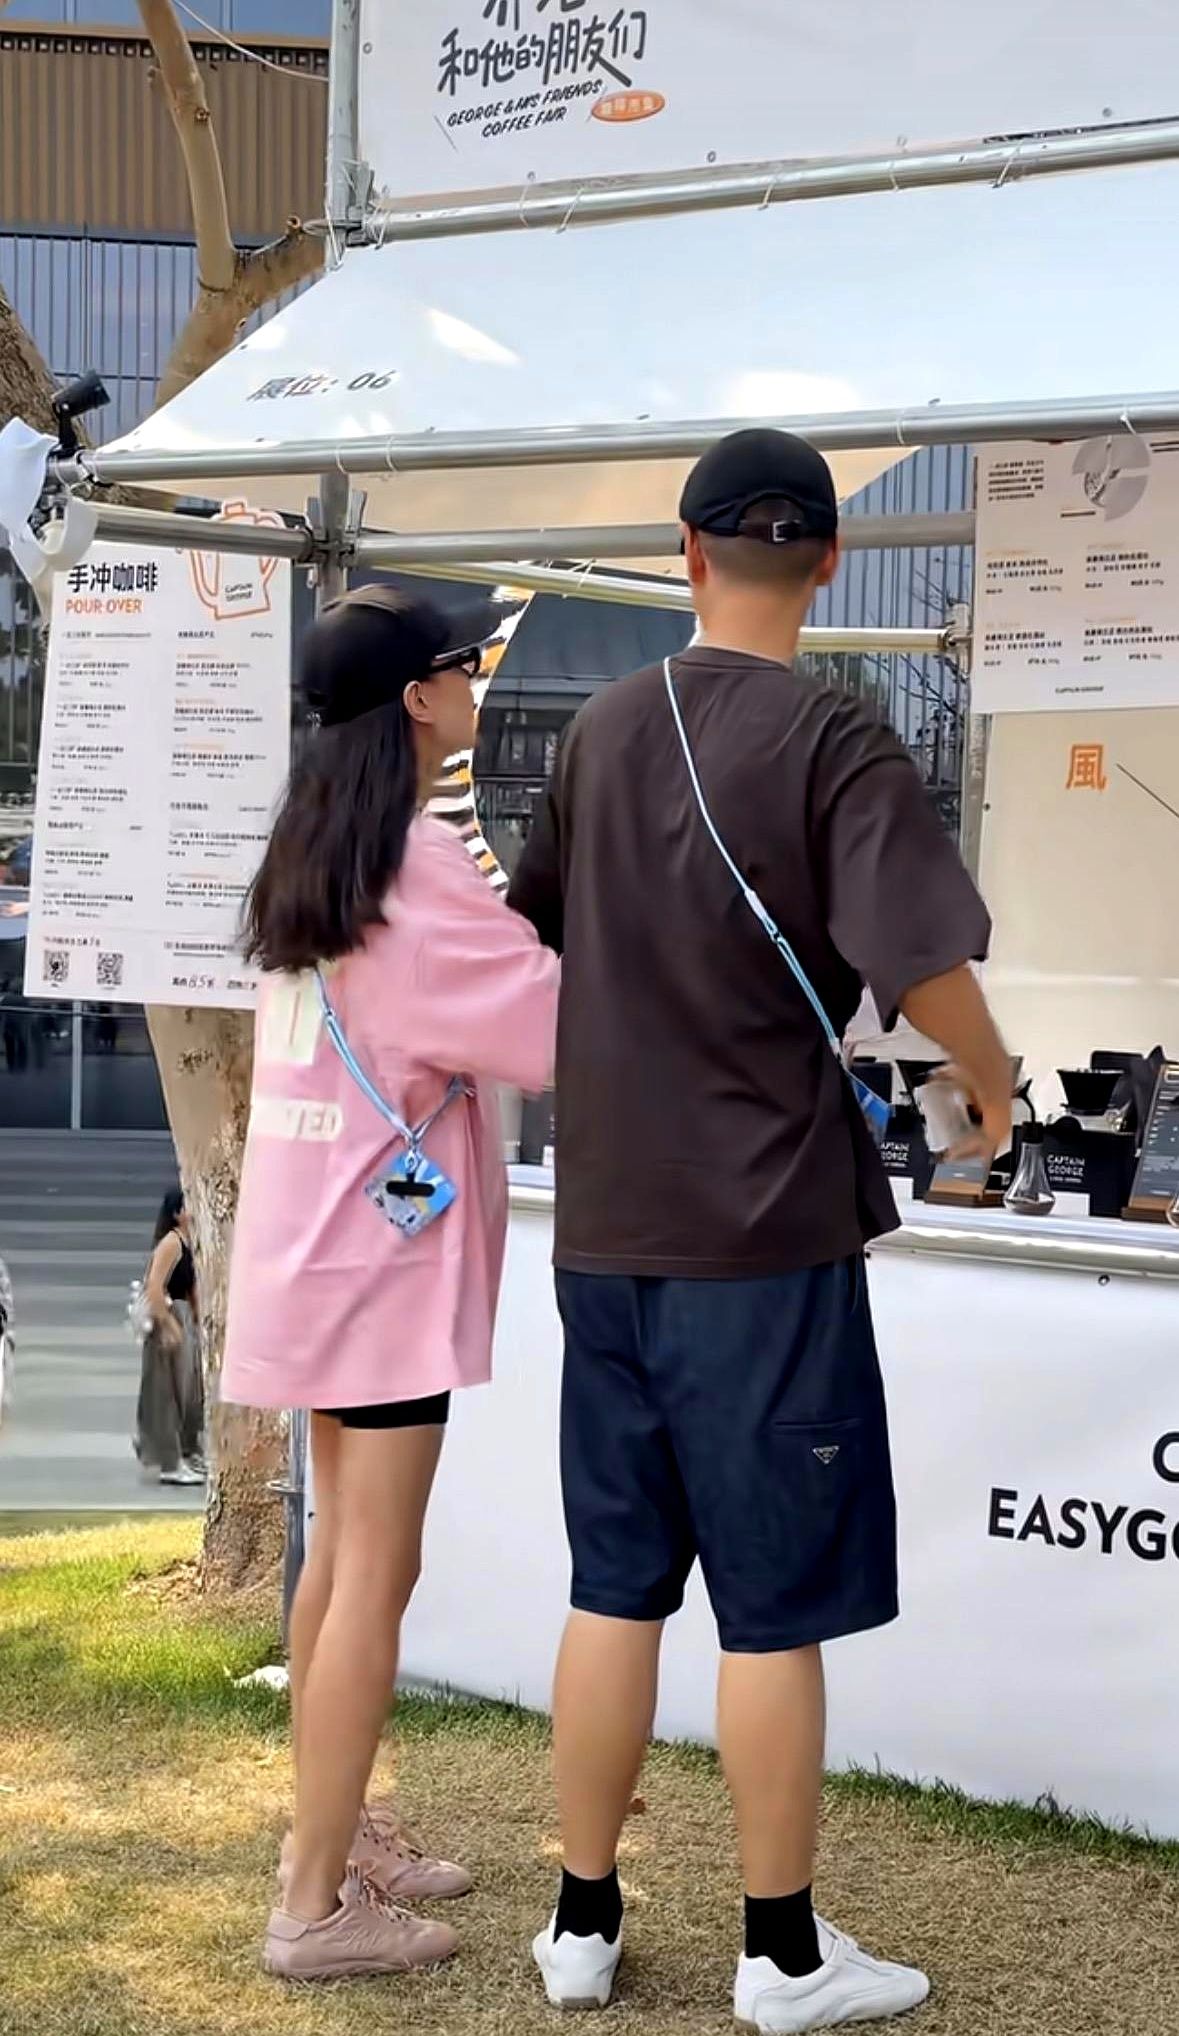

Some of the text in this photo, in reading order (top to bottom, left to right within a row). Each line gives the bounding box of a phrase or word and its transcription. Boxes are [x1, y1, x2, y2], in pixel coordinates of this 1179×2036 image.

[437, 8, 647, 95] 和他的朋友们
[447, 101, 503, 127] GEORGE
[482, 113, 534, 138] COFFEE
[66, 562, 158, 593] 手冲咖啡
[65, 598, 143, 614] POUR OVER
[1065, 744, 1107, 791] 風
[988, 1487, 1179, 1561] EASYG
